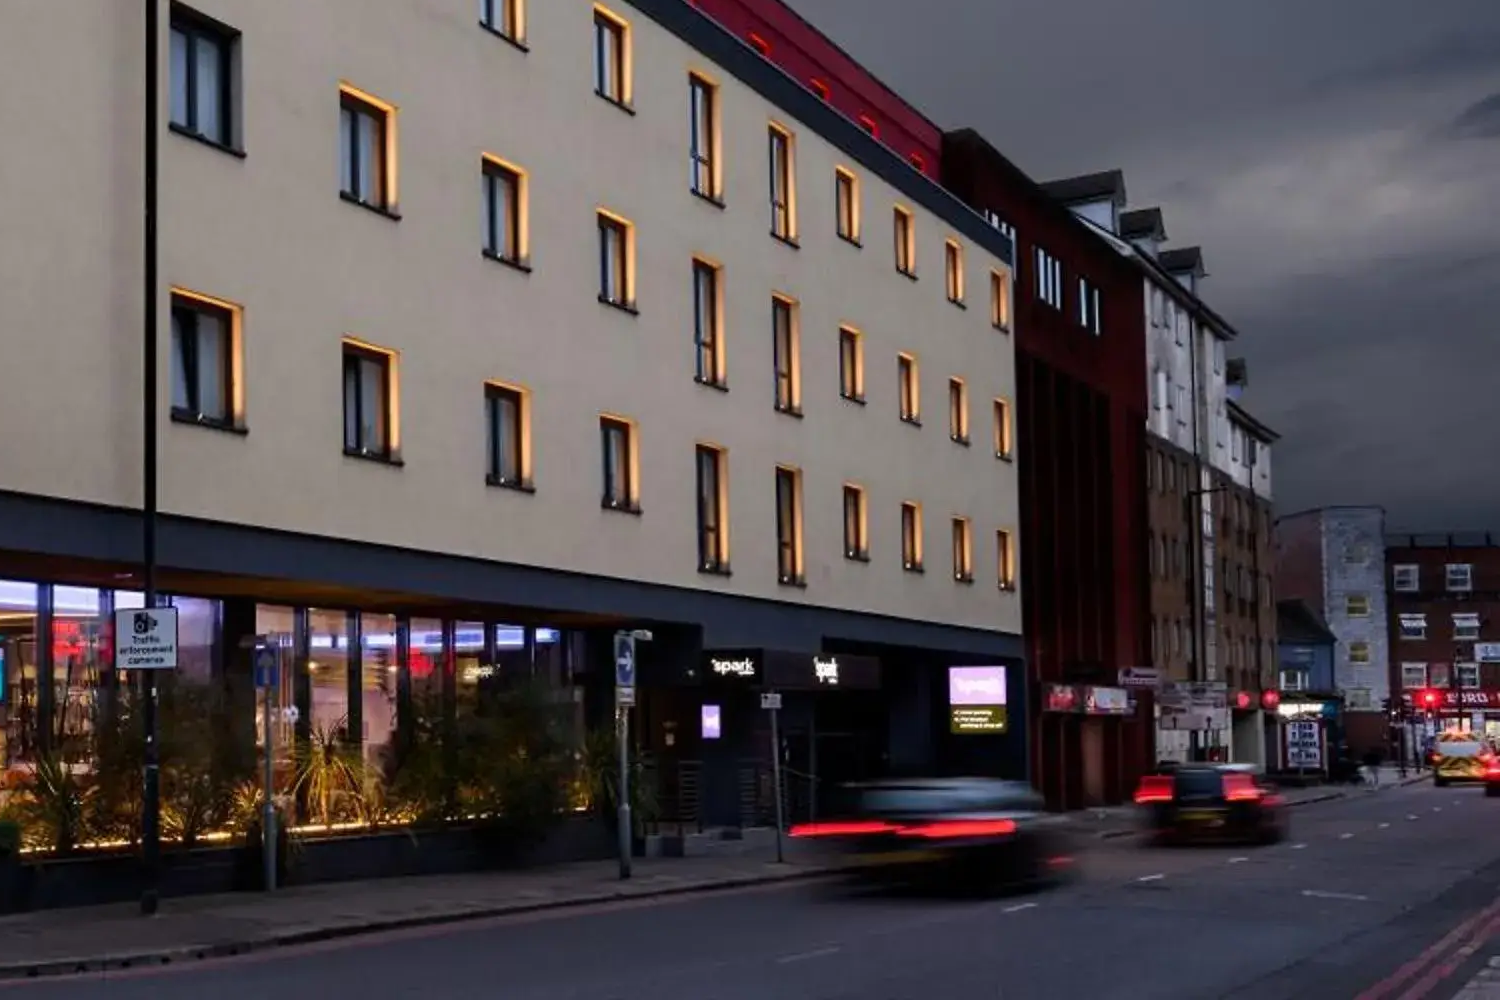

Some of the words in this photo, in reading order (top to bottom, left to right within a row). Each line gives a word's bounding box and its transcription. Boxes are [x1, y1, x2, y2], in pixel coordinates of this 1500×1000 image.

[131, 635, 161, 645] Traffic
[119, 645, 173, 655] enforcement
[127, 657, 166, 665] cameras
[712, 656, 755, 677] spark
